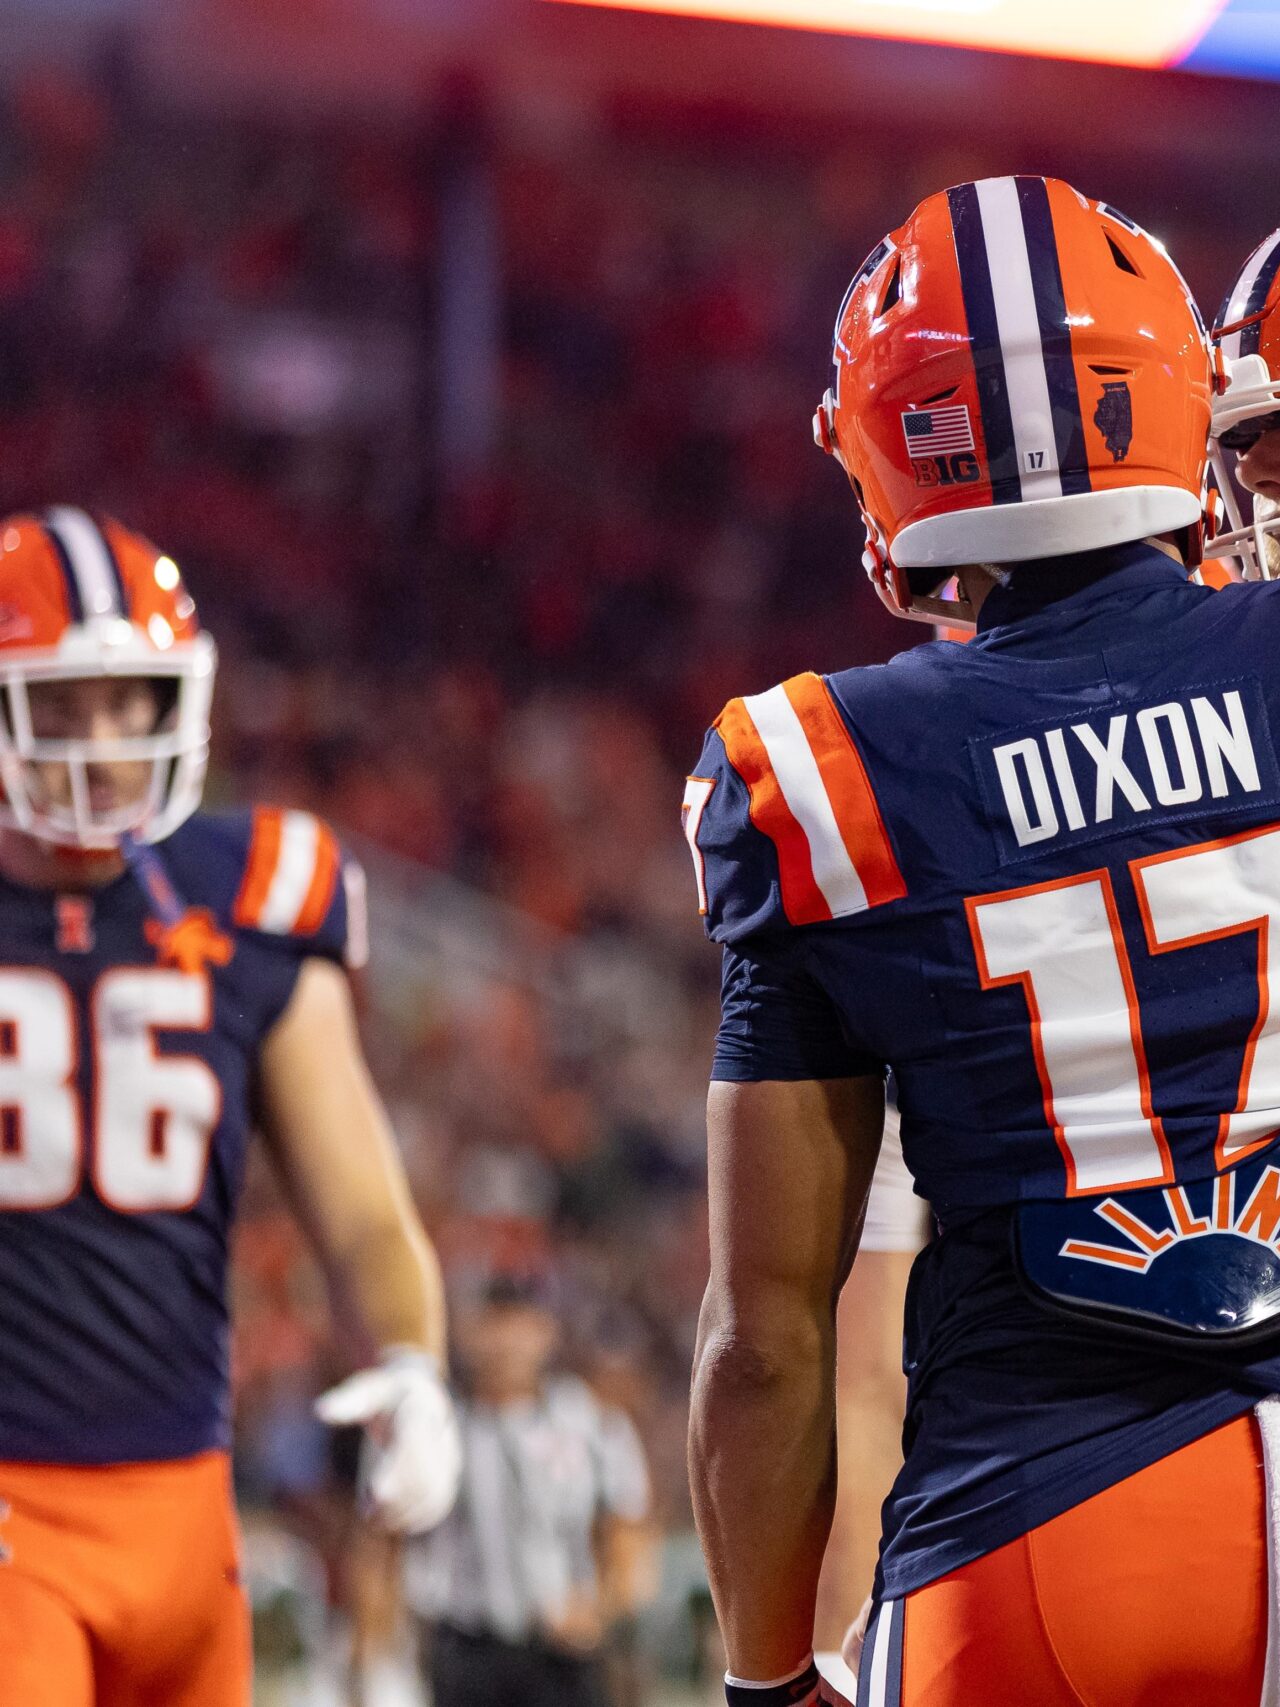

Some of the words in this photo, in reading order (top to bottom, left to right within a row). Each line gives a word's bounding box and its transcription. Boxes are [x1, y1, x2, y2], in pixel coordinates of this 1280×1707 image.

[1028, 451, 1045, 469] 17
[992, 691, 1262, 847] DIXON
[0, 960, 221, 1213] 86
